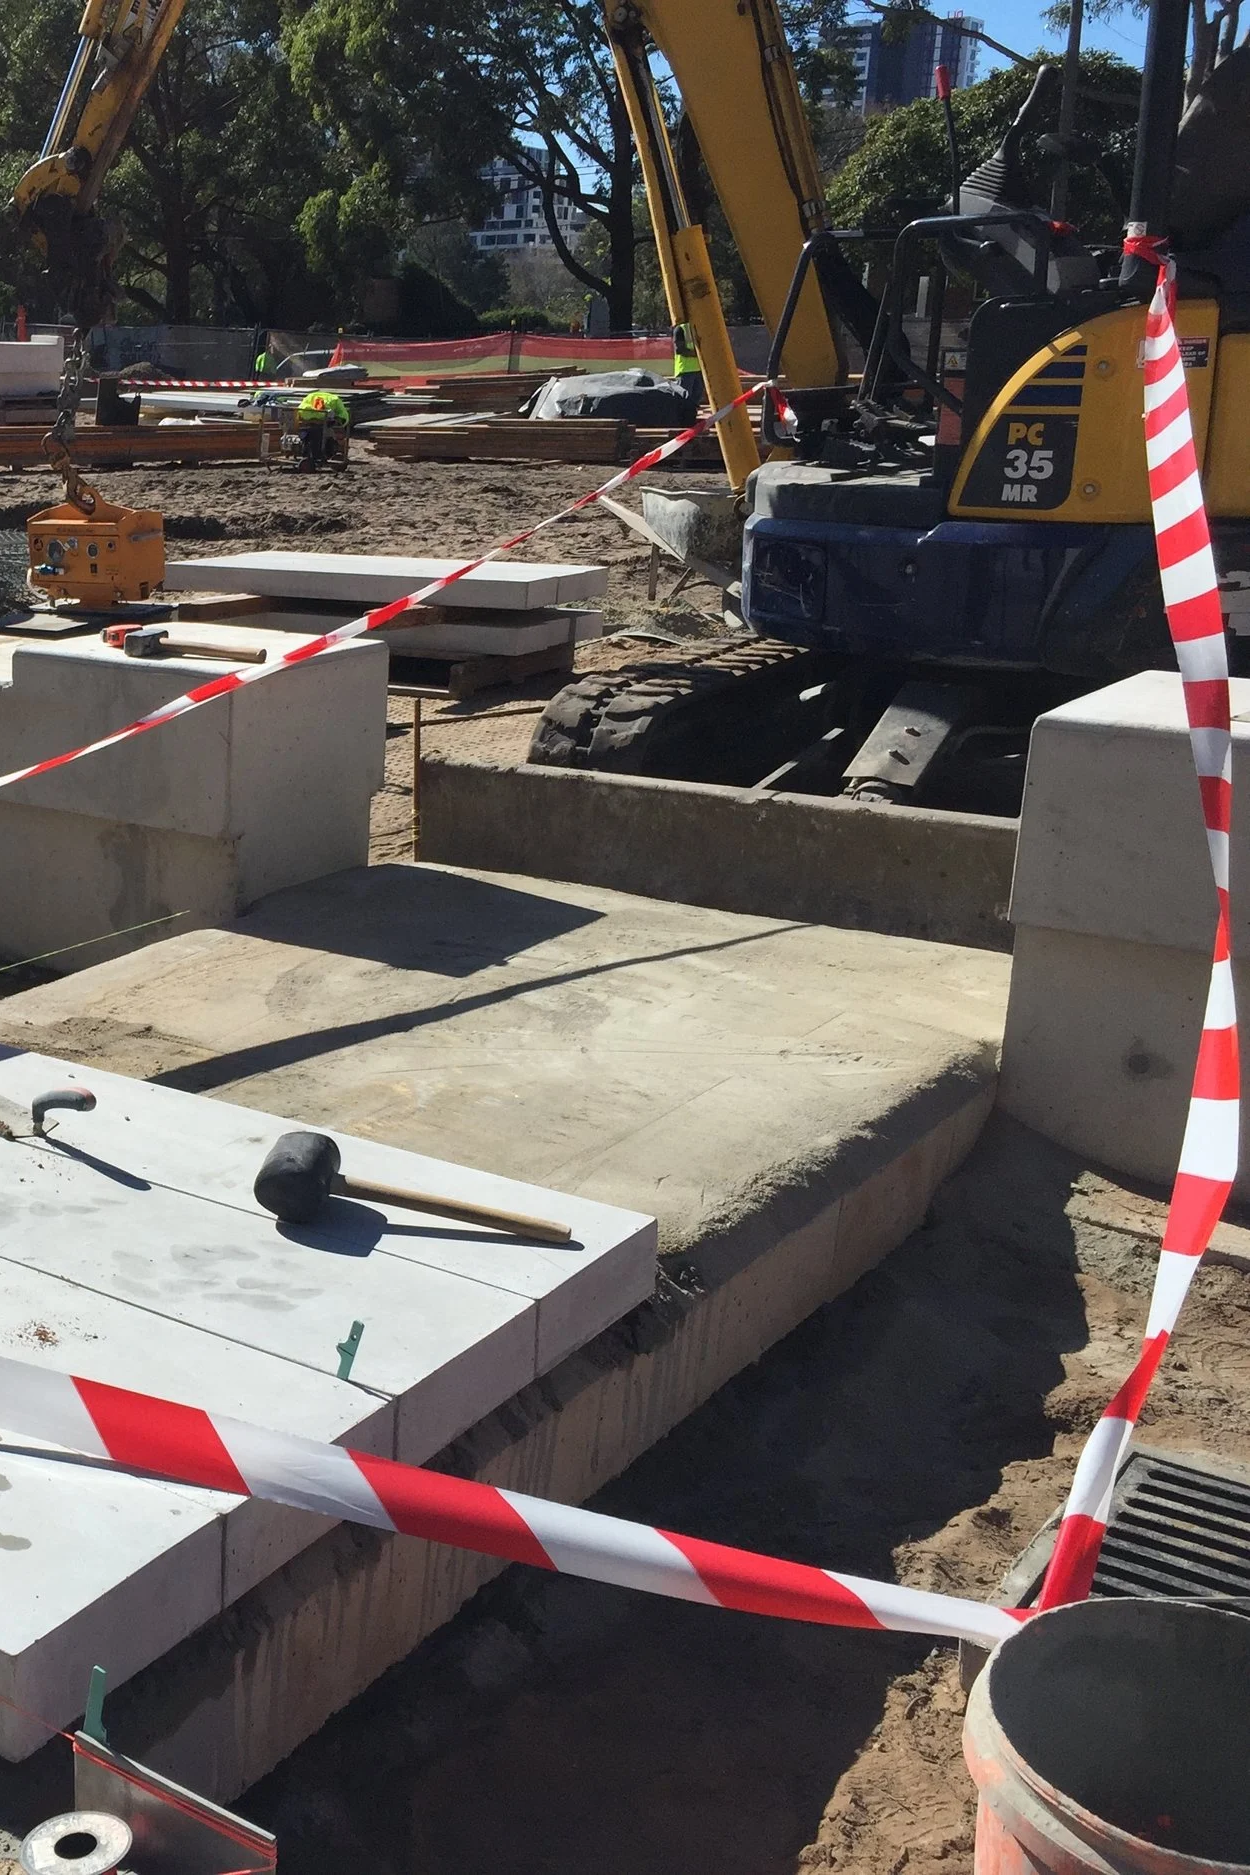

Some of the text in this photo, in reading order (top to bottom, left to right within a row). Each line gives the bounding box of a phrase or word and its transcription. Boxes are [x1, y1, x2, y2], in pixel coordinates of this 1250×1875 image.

[1007, 422, 1045, 446] PC
[1003, 449, 1054, 480] 35
[1001, 483, 1038, 502] MR
